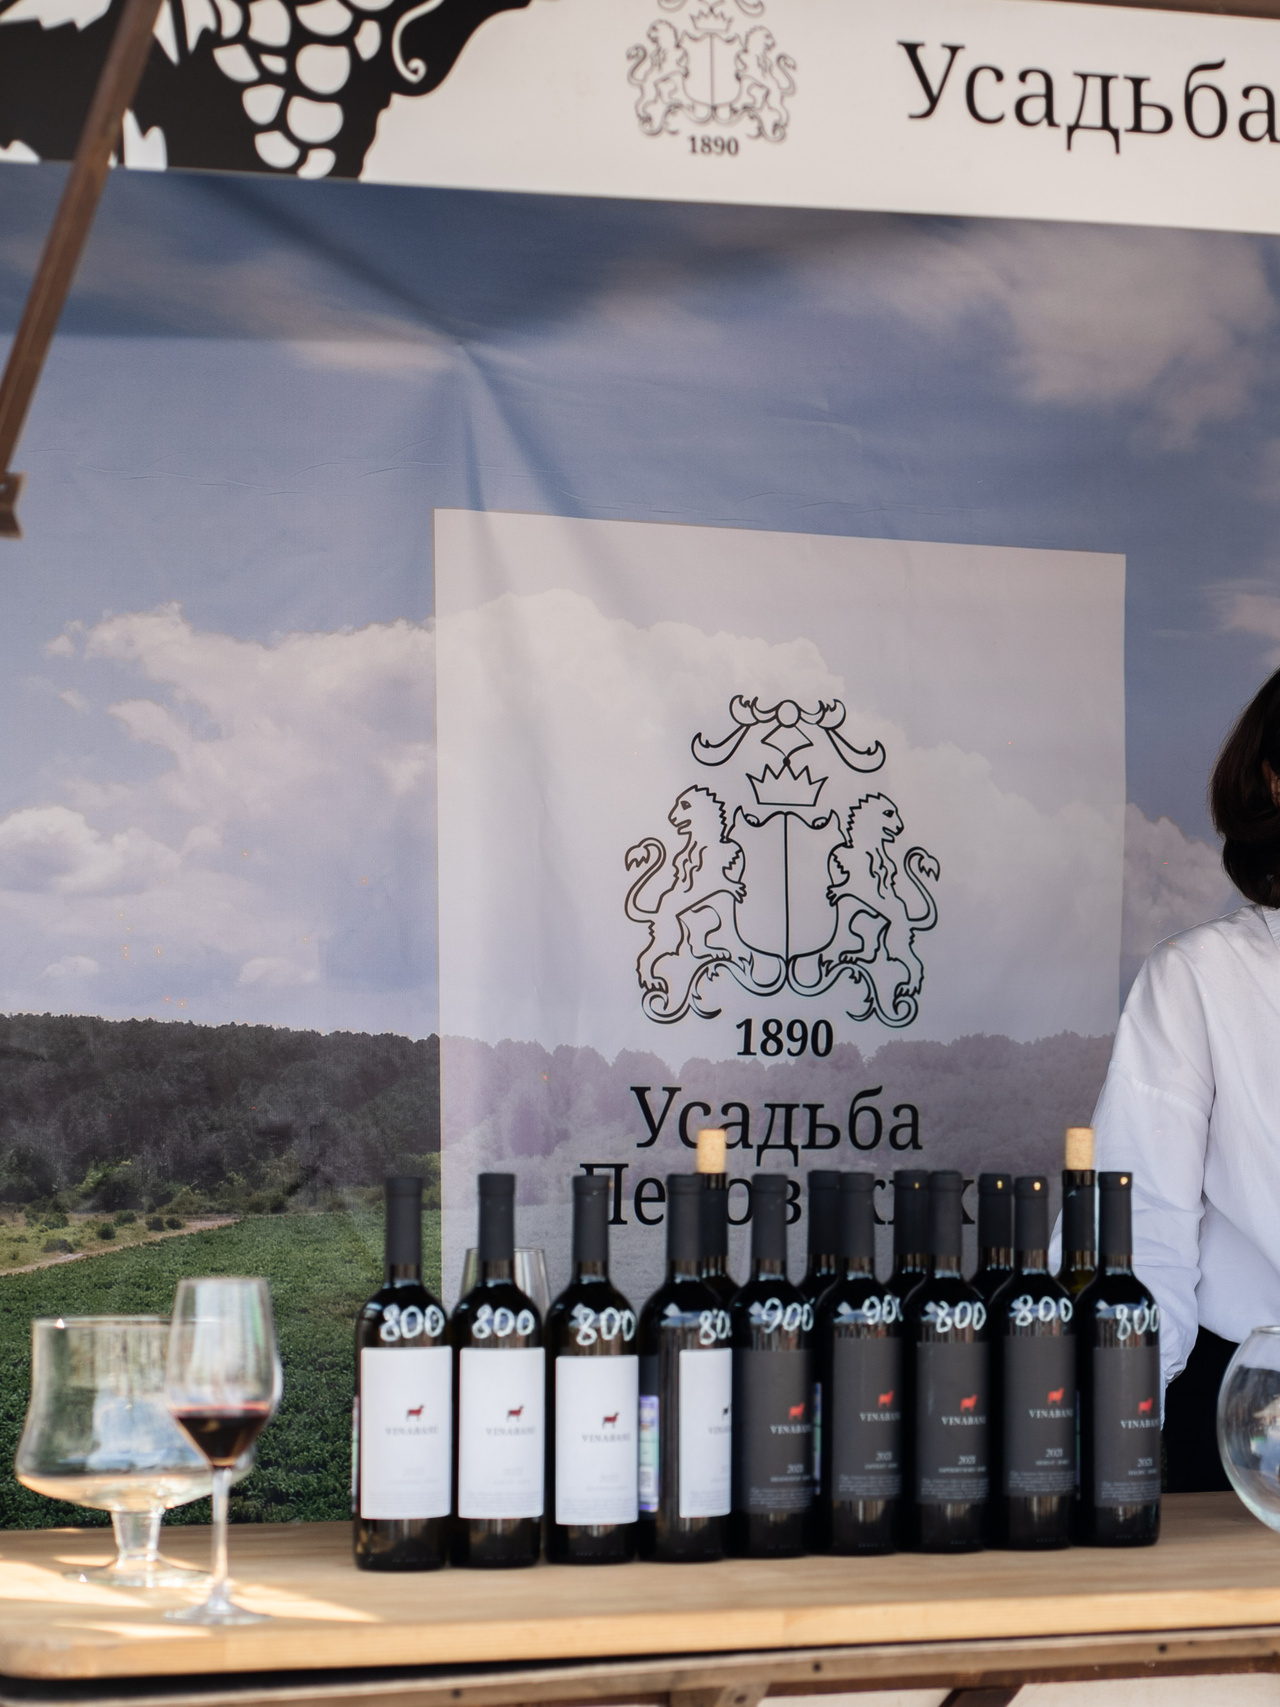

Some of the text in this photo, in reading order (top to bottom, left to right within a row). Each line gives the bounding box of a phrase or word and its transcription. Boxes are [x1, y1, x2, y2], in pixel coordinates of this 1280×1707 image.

[688, 135, 739, 156] 1890
[735, 1018, 834, 1057] 1890
[629, 1085, 923, 1167] Усадьба
[379, 1304, 444, 1342] 800
[471, 1304, 534, 1339] 800
[576, 1307, 635, 1346] 800
[698, 1309, 731, 1346] 80
[761, 1297, 814, 1334] 900
[936, 1300, 986, 1333] 800
[1015, 1294, 1072, 1326] 800
[1115, 1302, 1159, 1341] 800
